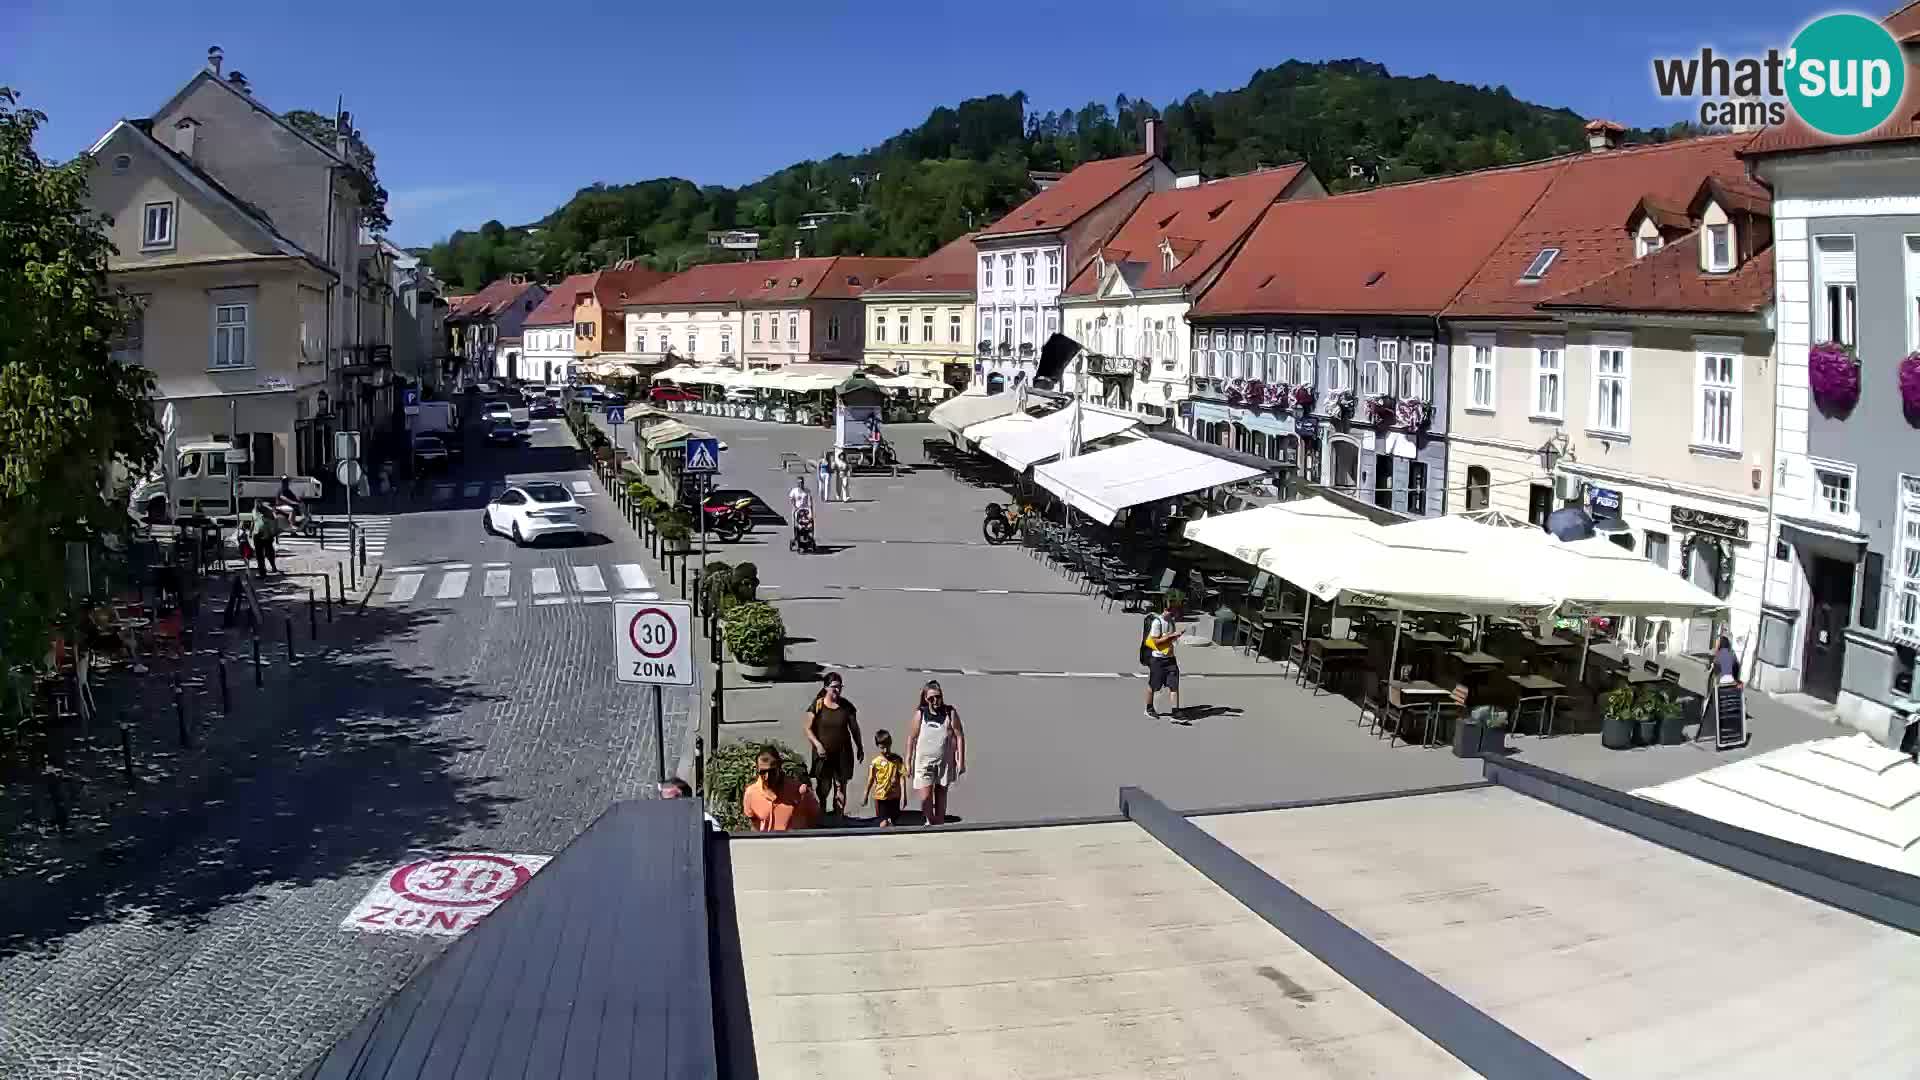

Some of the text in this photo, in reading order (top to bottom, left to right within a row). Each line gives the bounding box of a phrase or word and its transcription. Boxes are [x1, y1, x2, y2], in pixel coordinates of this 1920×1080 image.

[642, 624, 665, 644] 30
[633, 661, 676, 678] ZONA
[419, 866, 502, 894] 30
